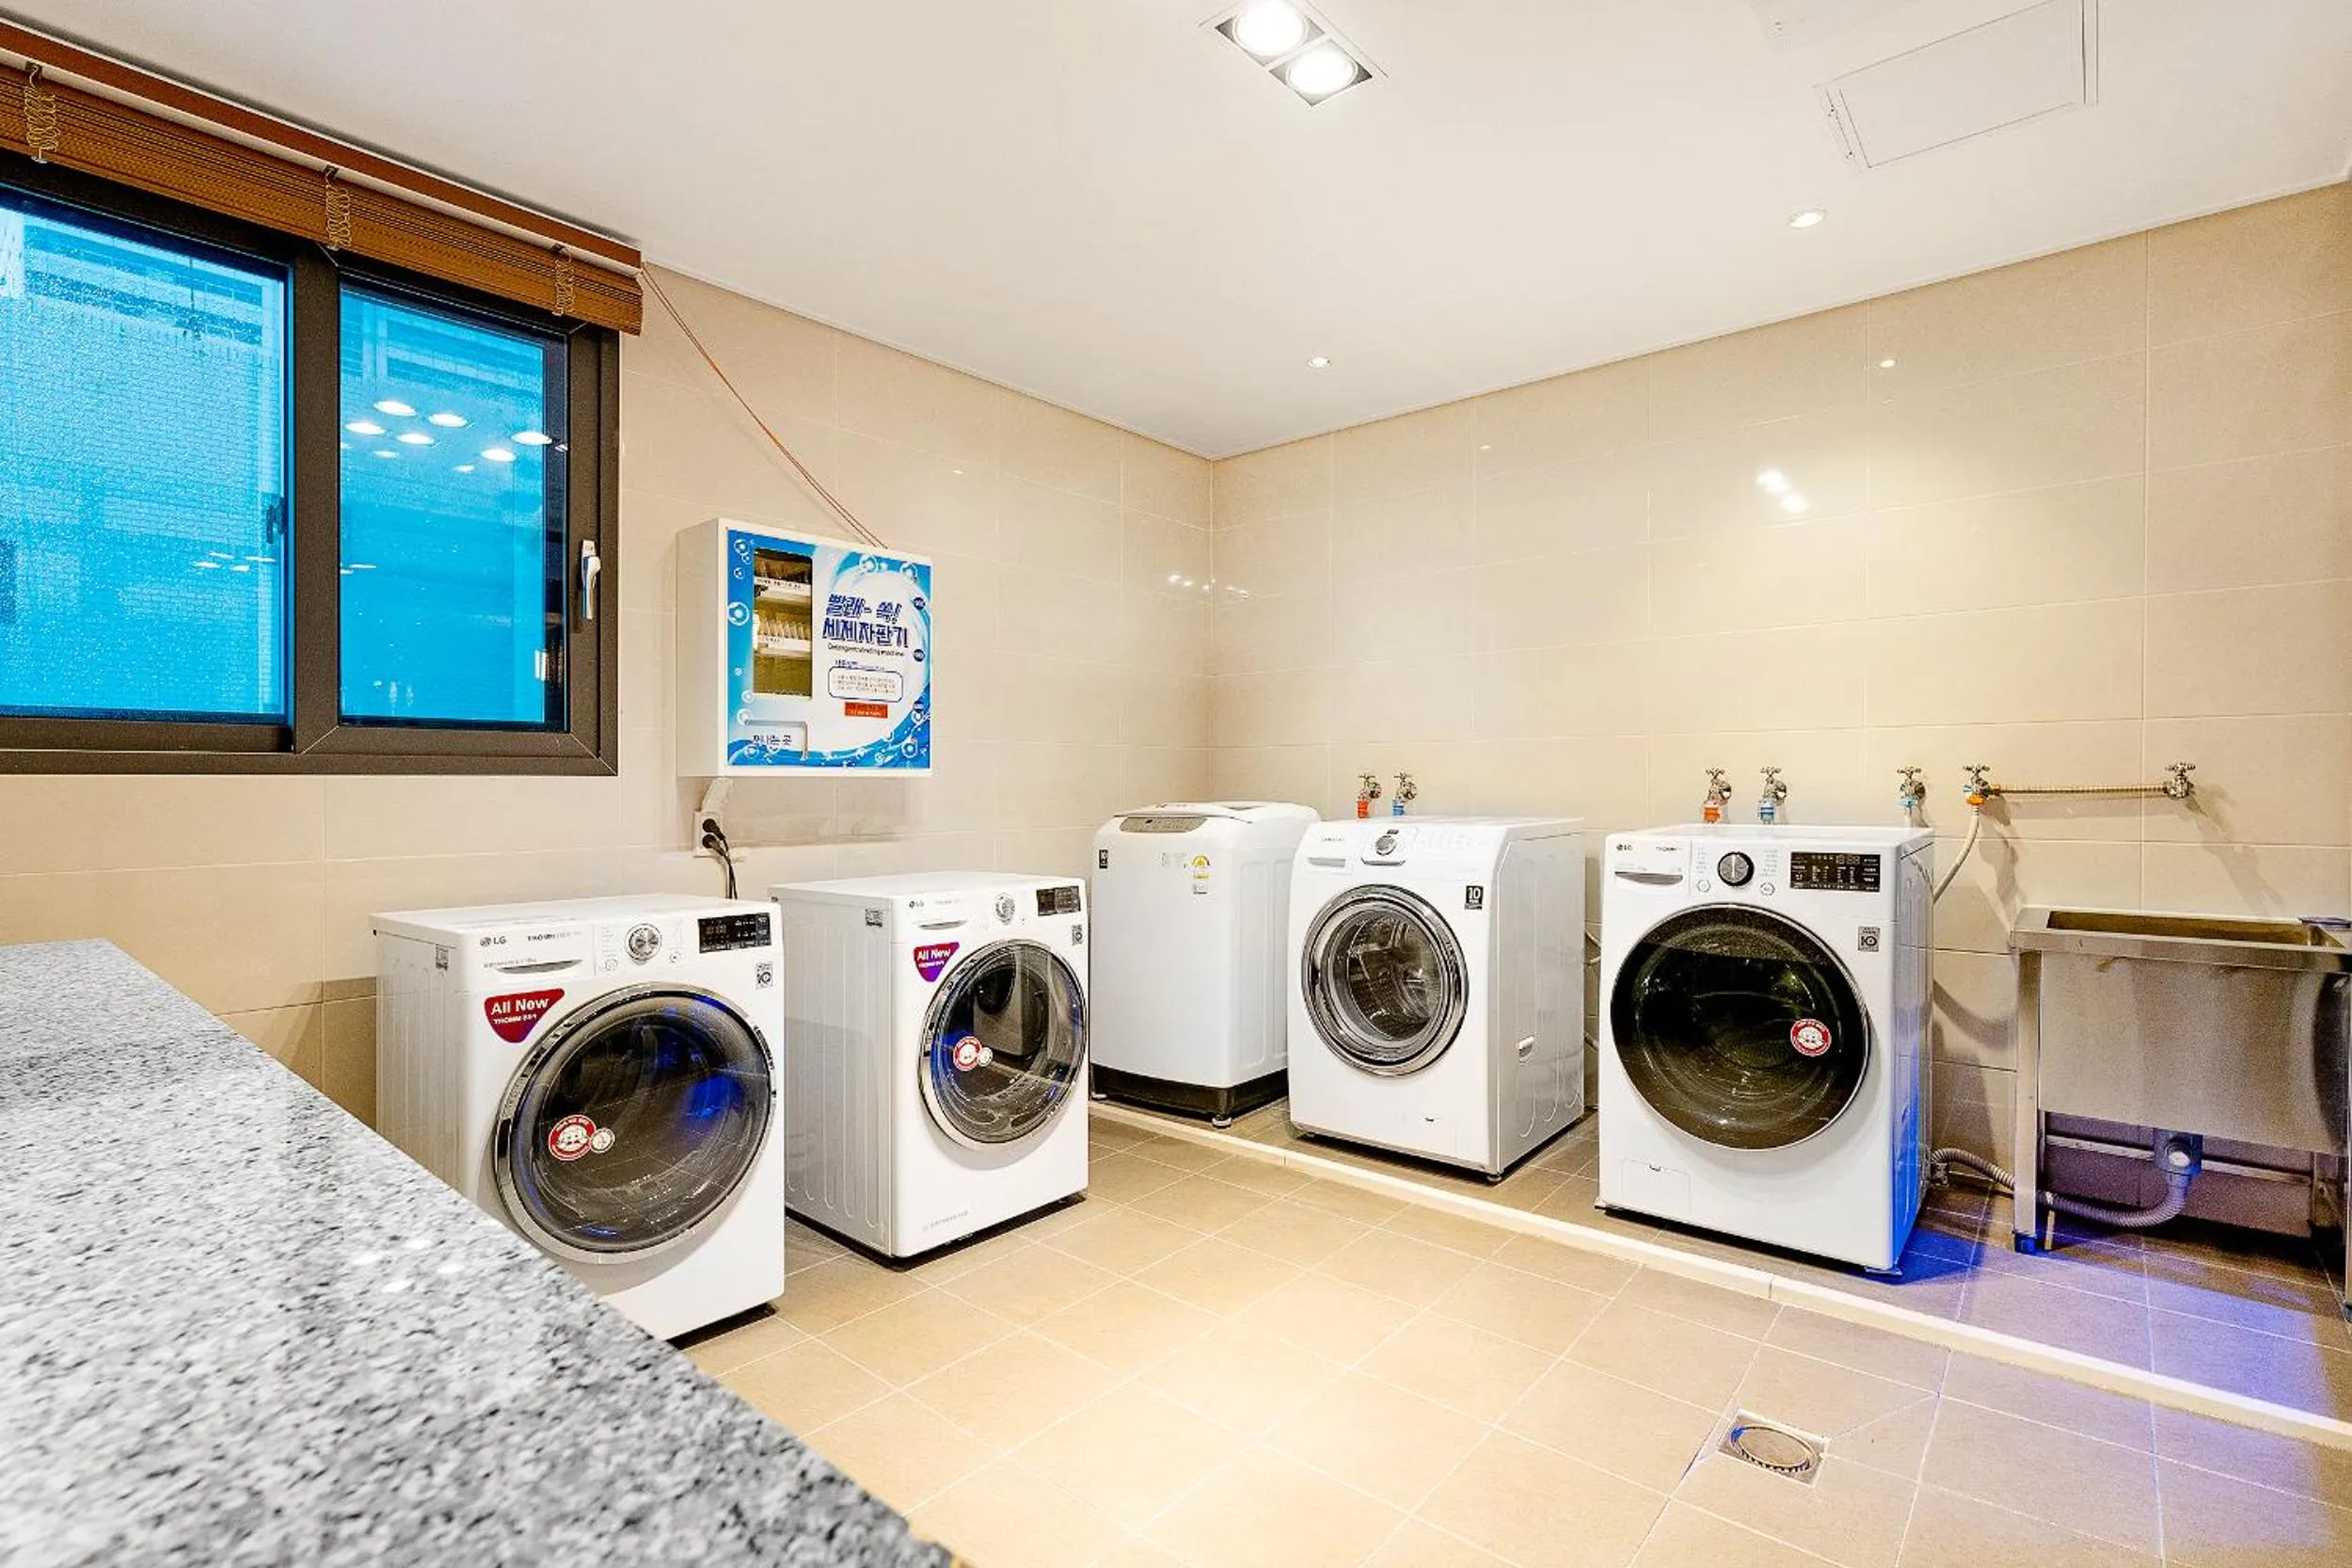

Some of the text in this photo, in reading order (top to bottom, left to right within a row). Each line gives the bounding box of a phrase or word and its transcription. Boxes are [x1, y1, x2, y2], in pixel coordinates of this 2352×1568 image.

[822, 617, 909, 648] 세제자판기
[1468, 887, 1482, 900] 10
[493, 935, 508, 945] LG
[490, 998, 549, 1016] All New
